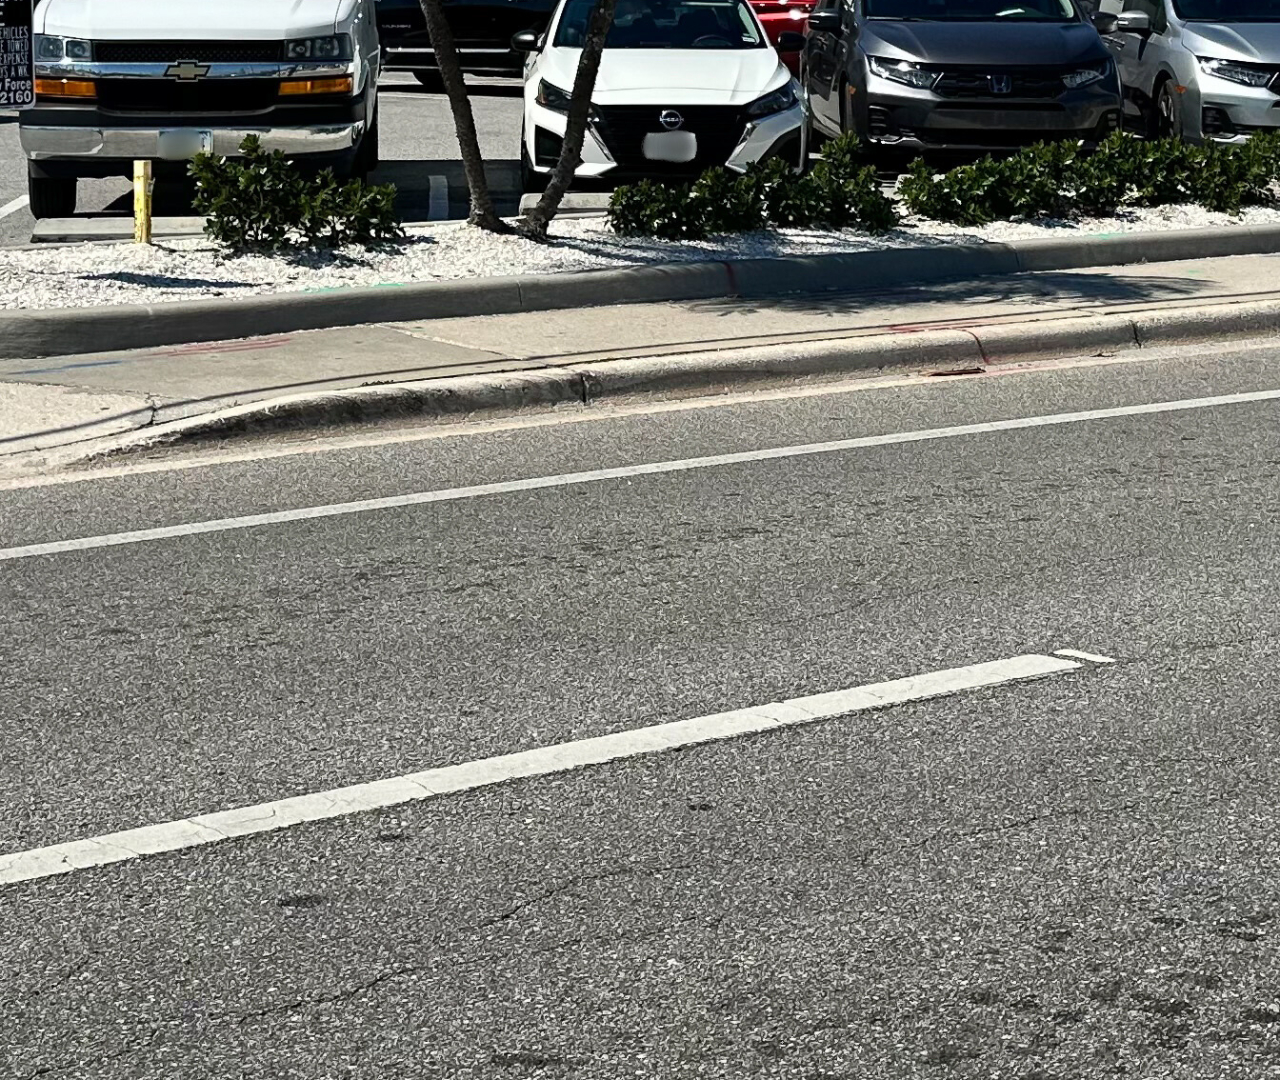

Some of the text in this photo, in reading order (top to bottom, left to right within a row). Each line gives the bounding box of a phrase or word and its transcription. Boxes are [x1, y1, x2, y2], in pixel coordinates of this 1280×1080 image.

[7, 39, 29, 52] TOWED
[0, 51, 29, 65] EXPENSE
[11, 65, 16, 77] A
[5, 78, 31, 91] Force
